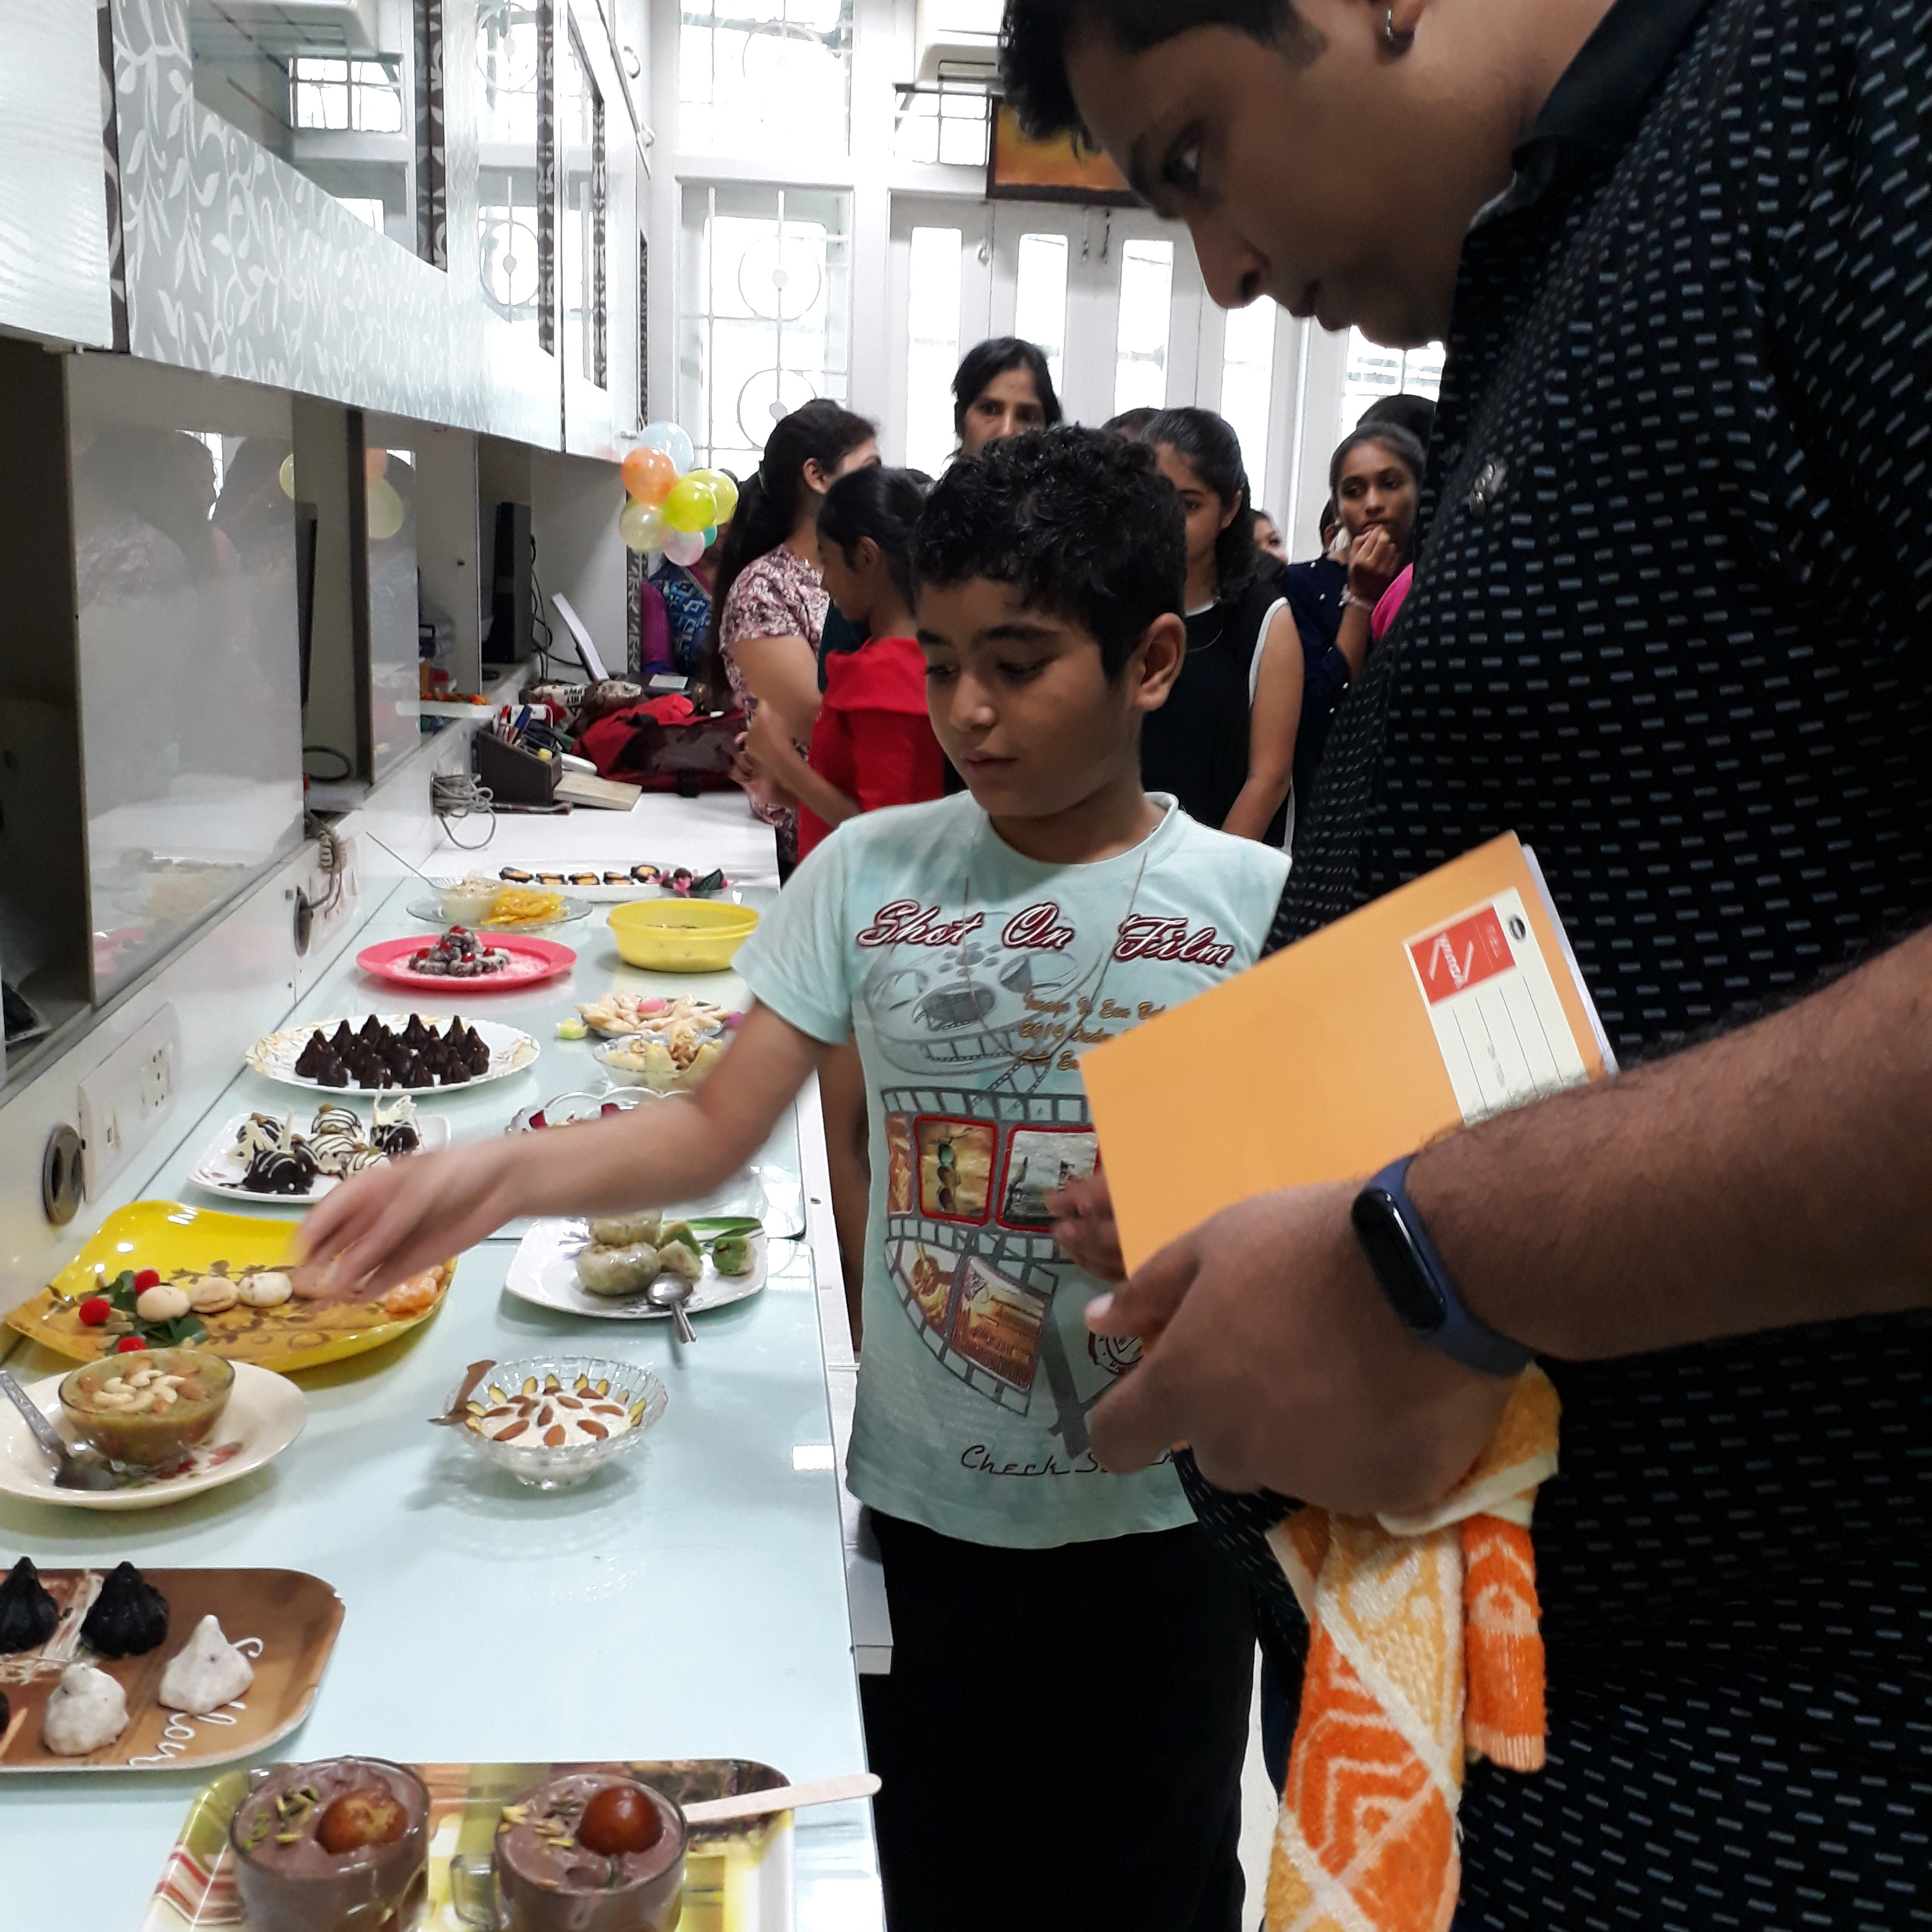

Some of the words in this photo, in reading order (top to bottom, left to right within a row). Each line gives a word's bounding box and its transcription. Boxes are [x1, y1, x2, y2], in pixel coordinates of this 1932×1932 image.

[857, 899, 984, 946] Shot
[1002, 901, 1075, 949] On
[1114, 914, 1236, 968] Film
[961, 1445, 1071, 1476] Check
